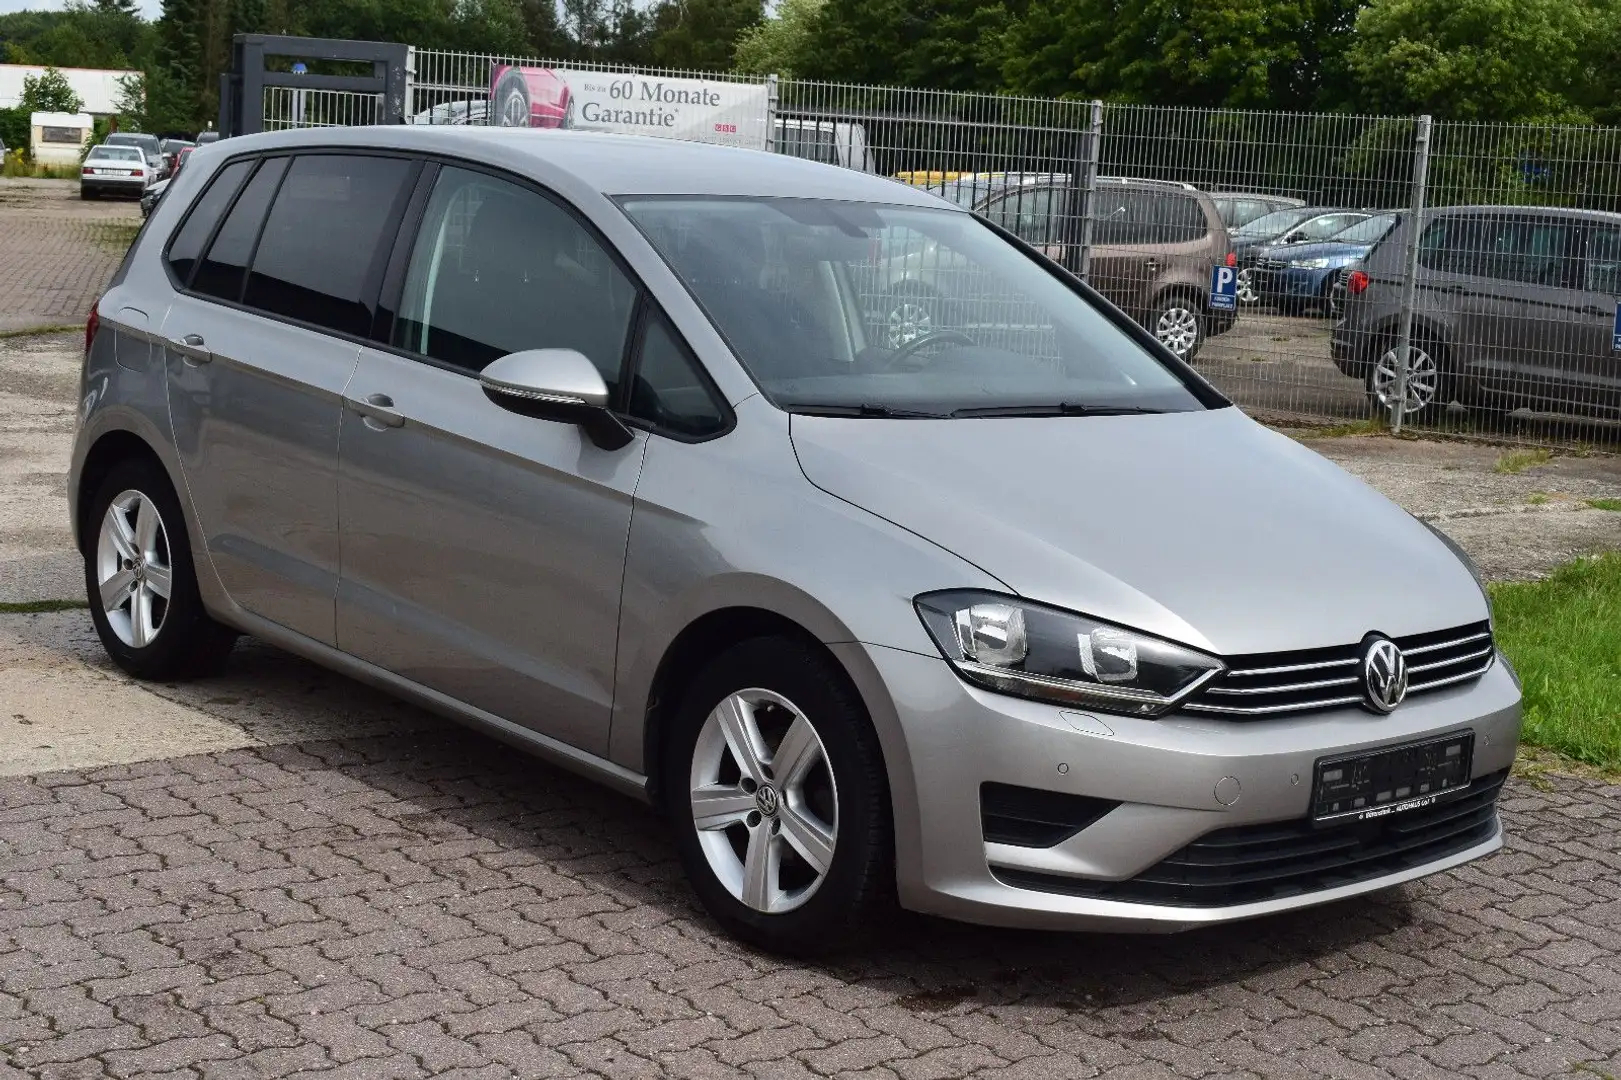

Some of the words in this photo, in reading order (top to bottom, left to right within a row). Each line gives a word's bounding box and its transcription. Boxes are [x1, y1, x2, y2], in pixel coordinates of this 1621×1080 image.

[609, 80, 634, 100] 60
[641, 81, 721, 107] Monate
[1217, 267, 1233, 293] P
